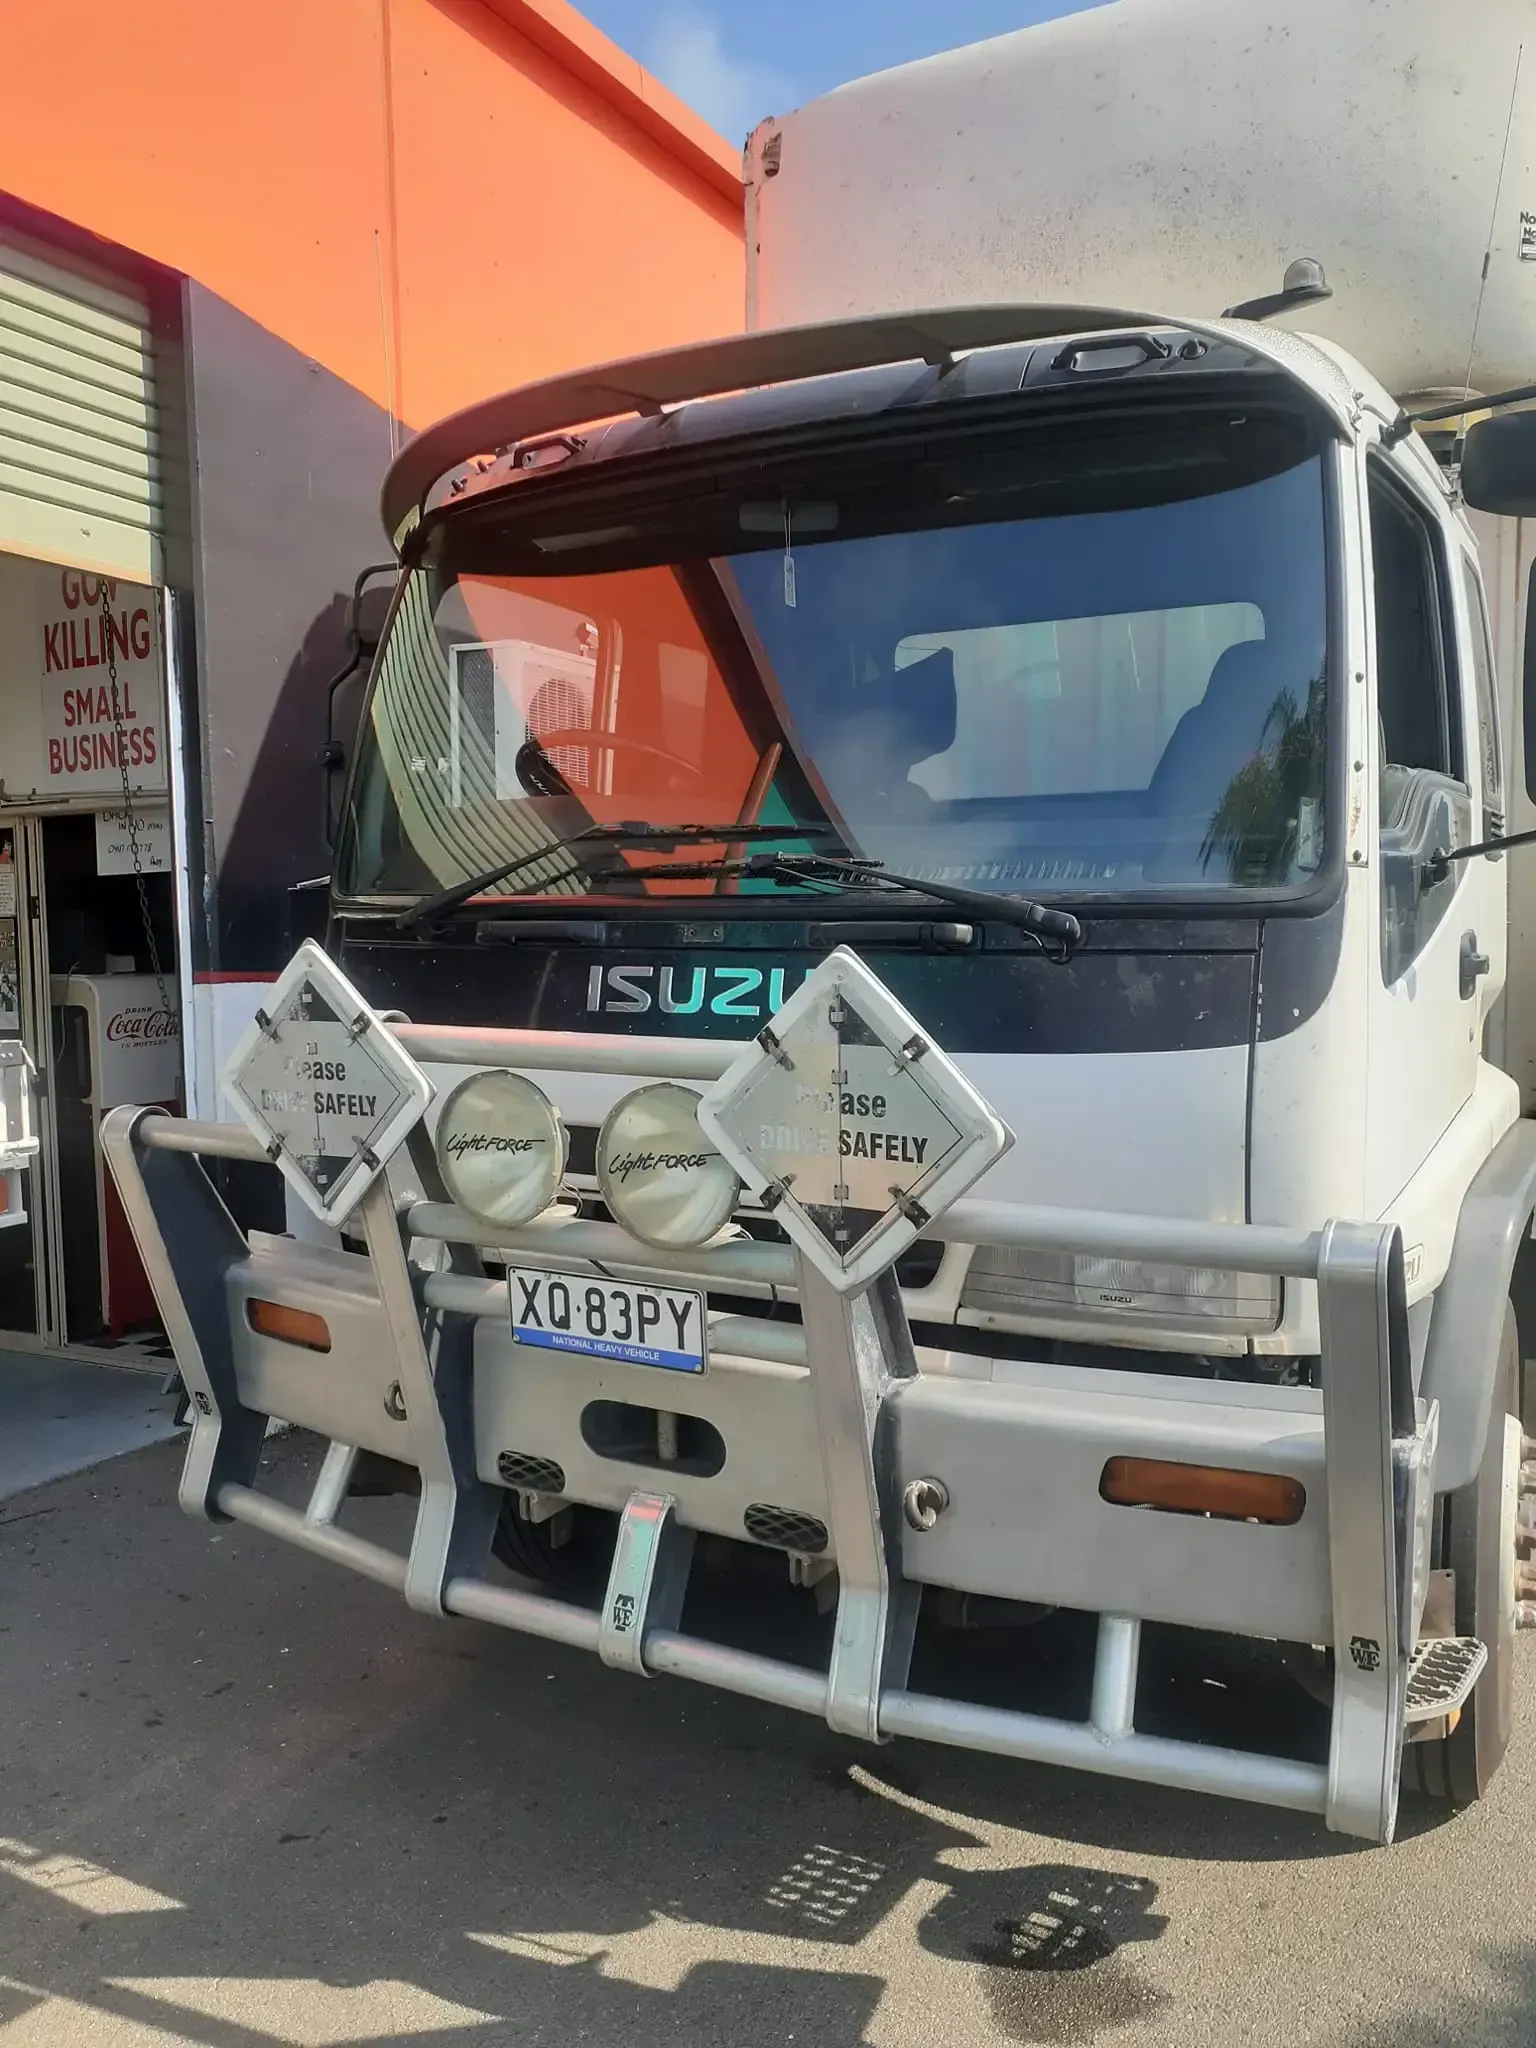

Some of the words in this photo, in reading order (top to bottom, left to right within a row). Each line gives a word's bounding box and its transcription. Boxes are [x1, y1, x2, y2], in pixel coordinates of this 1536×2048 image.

[44, 608, 150, 673] KILLING
[63, 682, 137, 727] SMALL
[49, 727, 157, 774] BUSINESS
[586, 965, 816, 1016] ISUZU
[283, 1056, 346, 1081] ease
[314, 1091, 377, 1117] SAFELY
[838, 1129, 928, 1164] SAFELY
[1099, 1294, 1132, 1303] ISUZU
[552, 1335, 593, 1350] NATIONAL
[594, 1343, 624, 1355] HEAVY
[624, 1347, 660, 1361] VEHICLE
